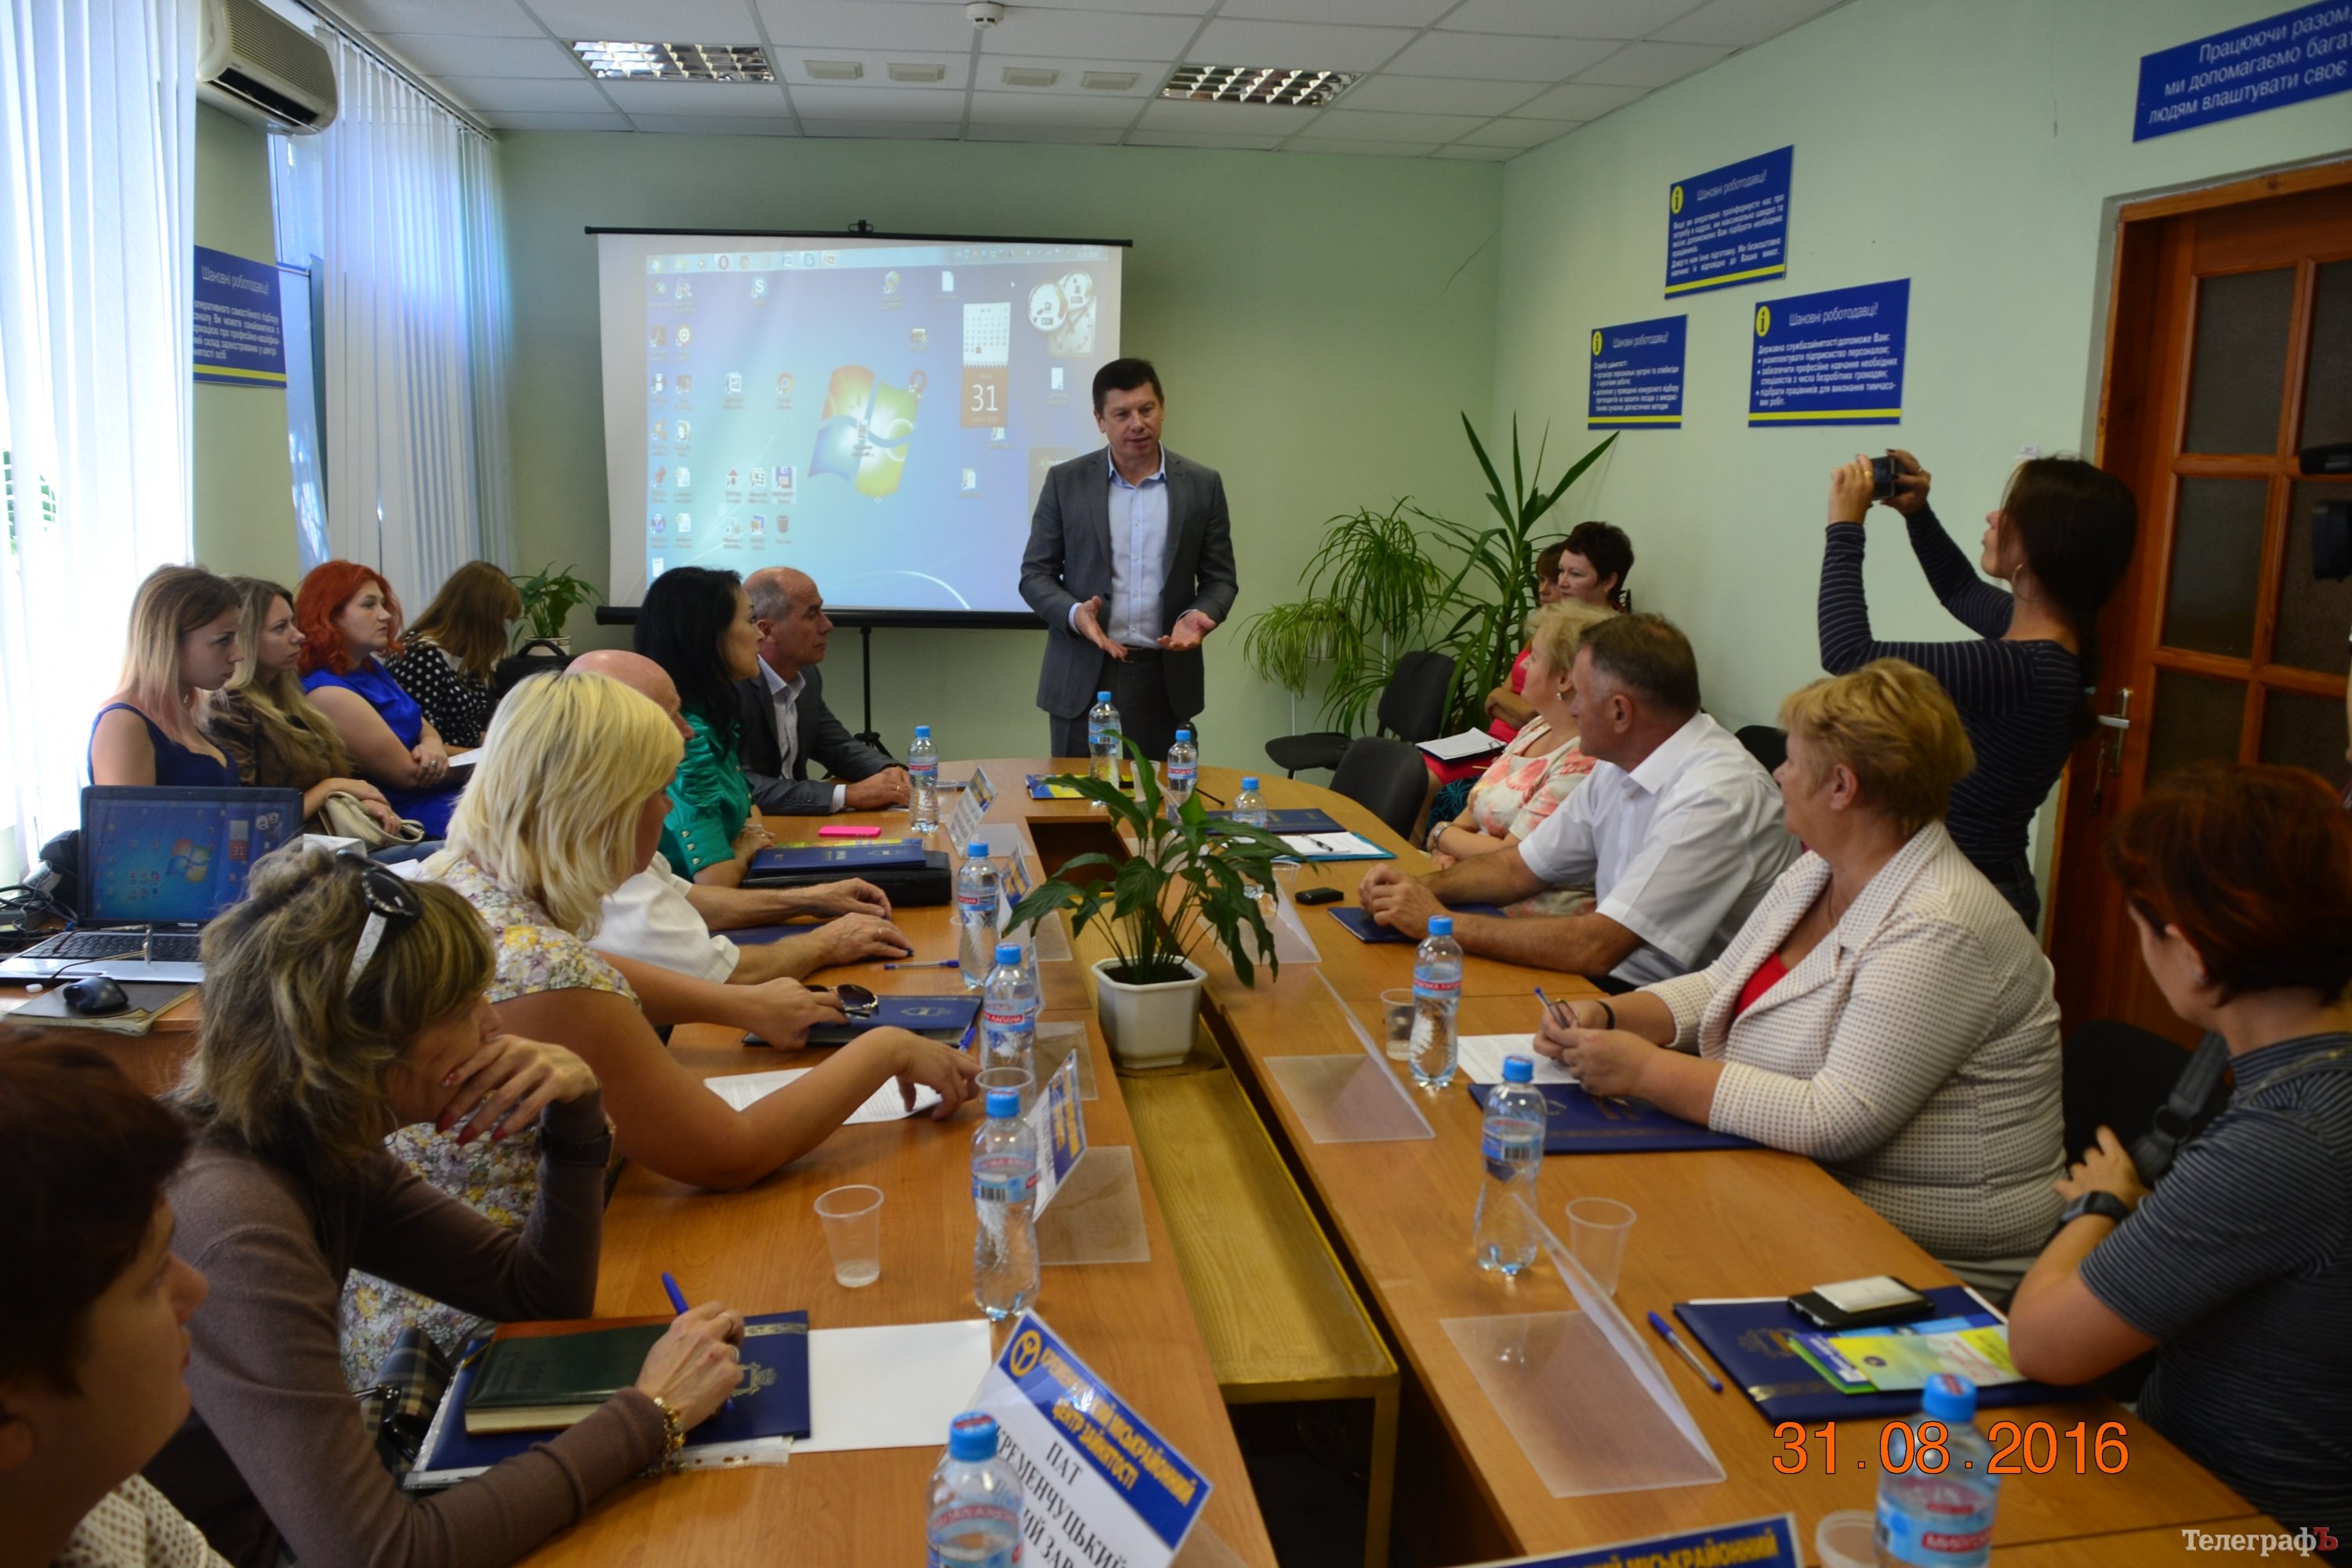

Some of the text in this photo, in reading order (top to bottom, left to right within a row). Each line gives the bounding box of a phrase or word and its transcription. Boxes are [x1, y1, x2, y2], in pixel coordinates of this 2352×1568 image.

[2198, 25, 2287, 64] Працюючи
[2165, 80, 2185, 96] ми
[2188, 45, 2301, 93] допомагаємо
[2148, 60, 2348, 124] людям влаштувати своє
[1789, 302, 1878, 326] Шановні роботодавці!
[971, 383, 999, 412] 31
[231, 846, 244, 857] 31
[1045, 1441, 1083, 1486] ПАТ
